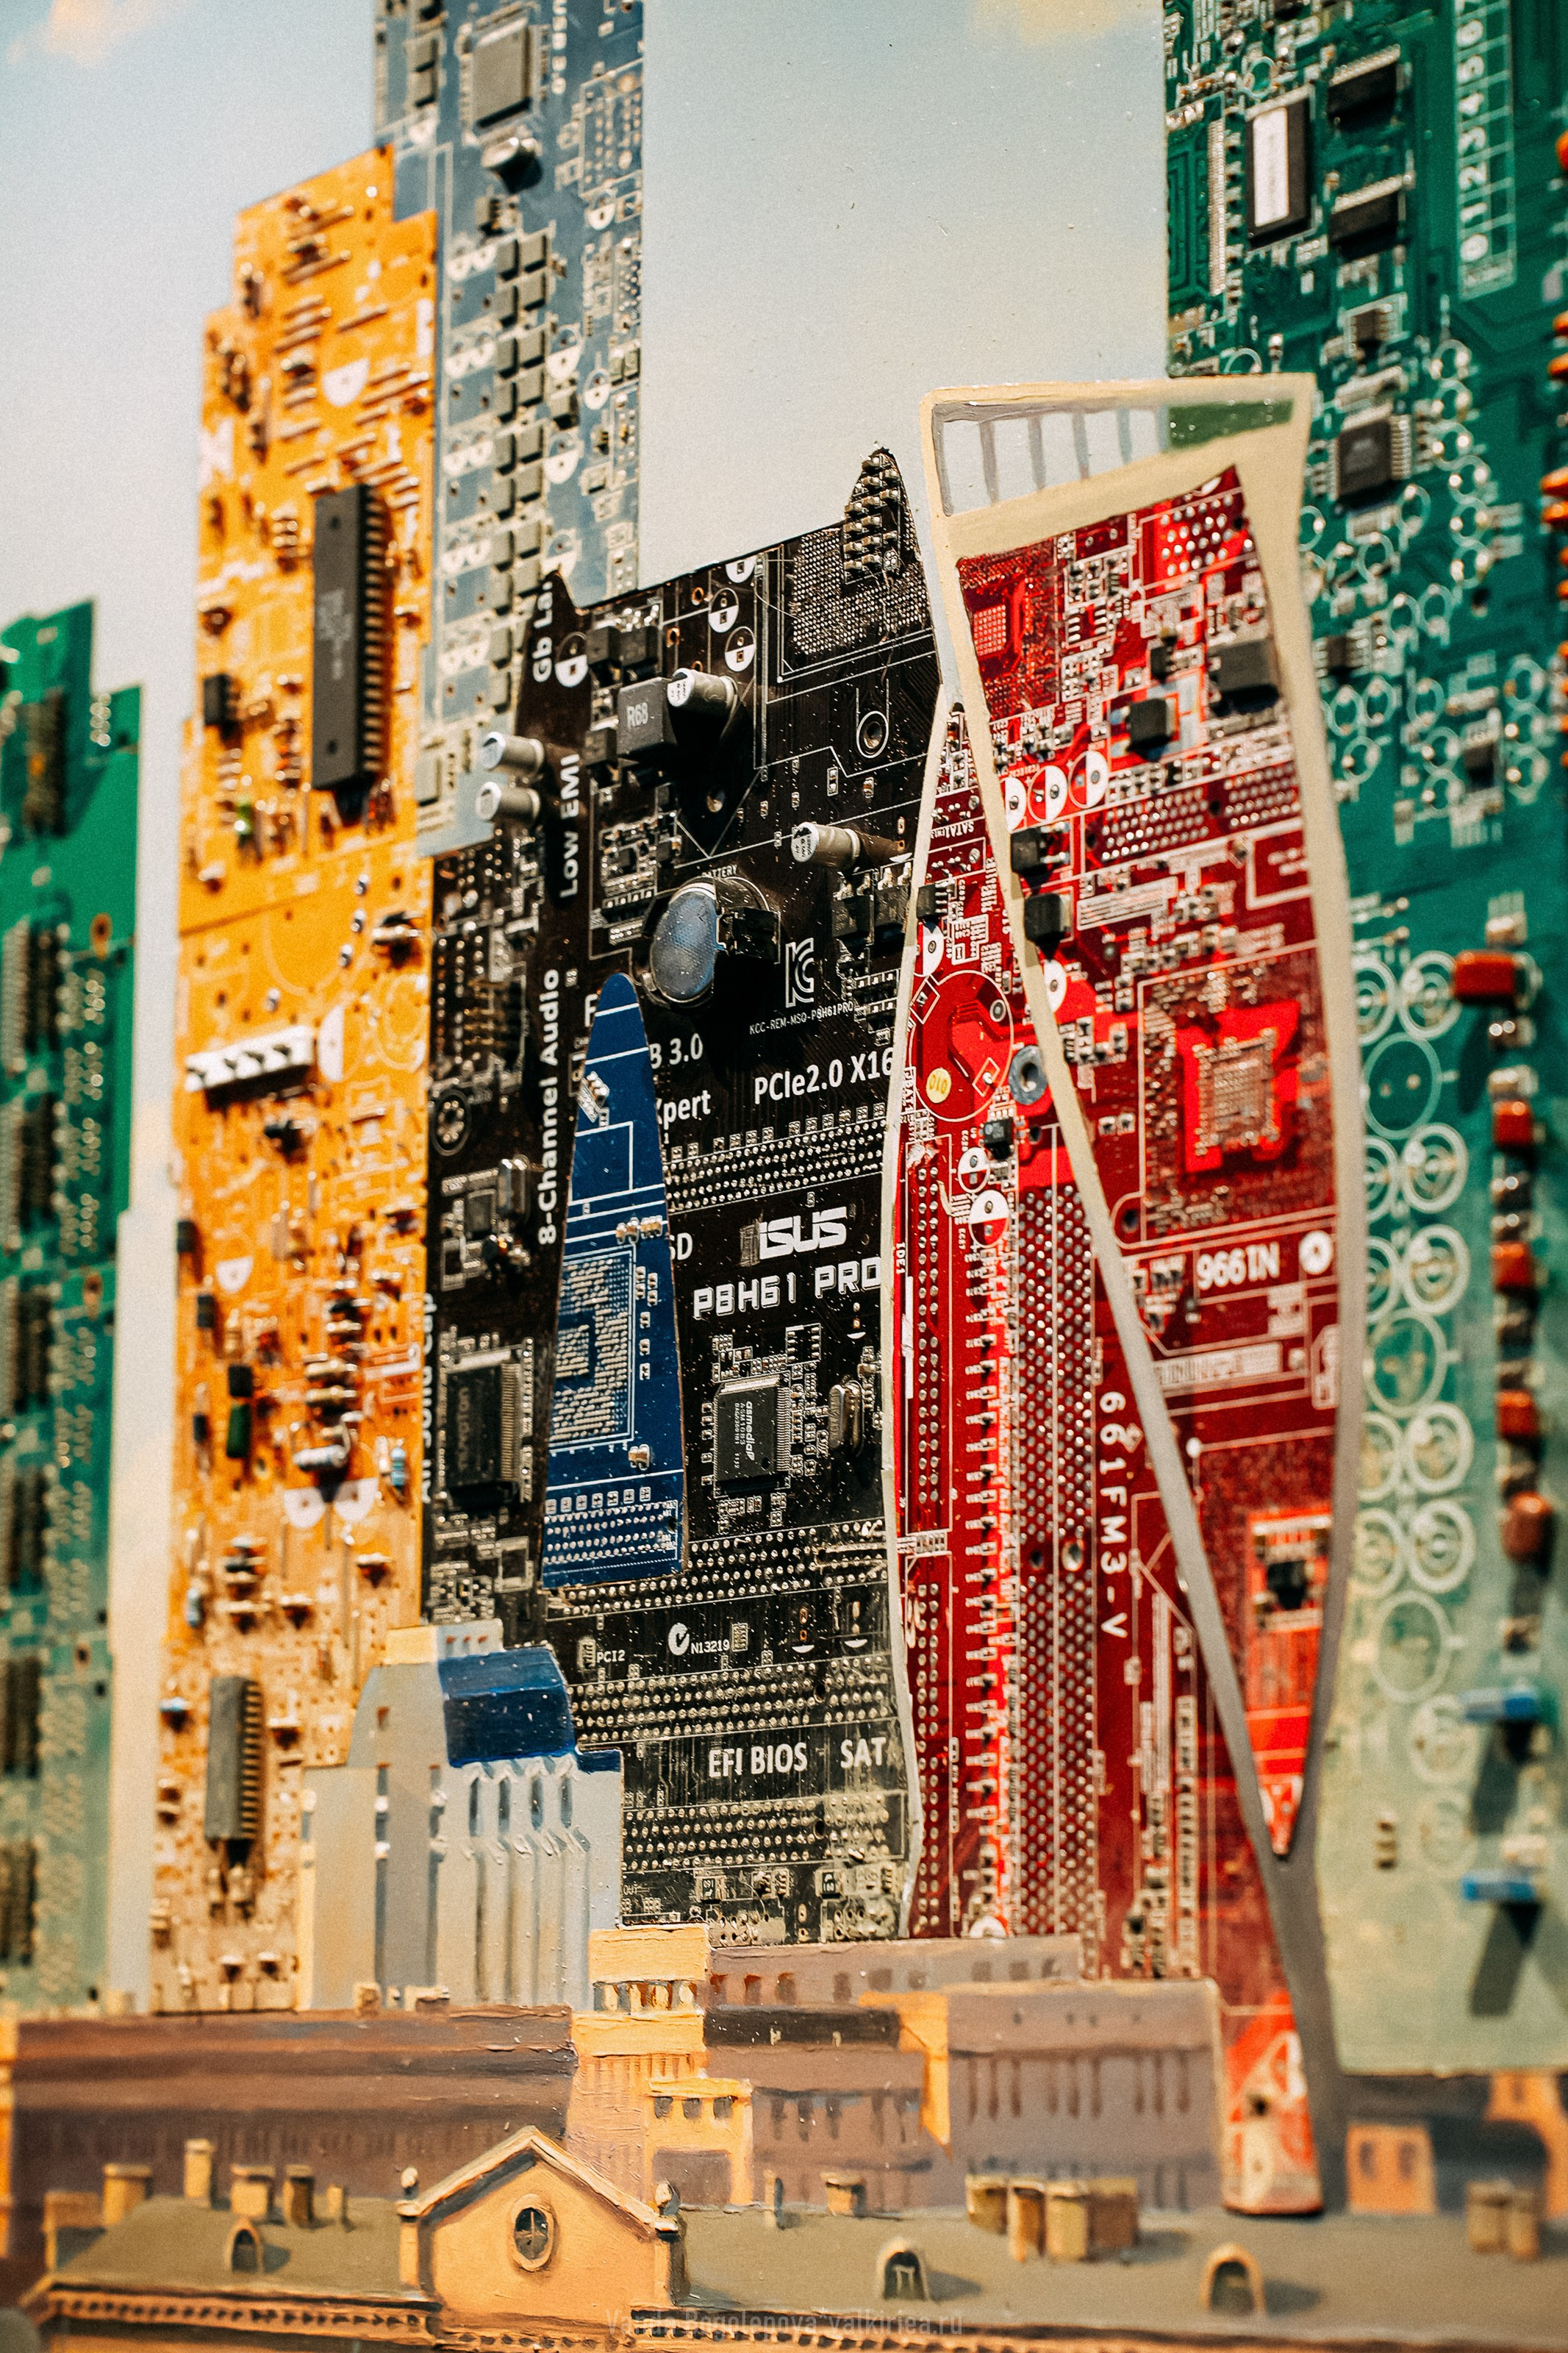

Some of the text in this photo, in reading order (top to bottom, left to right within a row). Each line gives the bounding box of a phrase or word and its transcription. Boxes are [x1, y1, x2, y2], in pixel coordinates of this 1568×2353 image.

[560, 754, 580, 819] EMI
[669, 1032, 704, 1065] 3.0
[850, 1046, 892, 1084] X16
[537, 969, 559, 1245] 8-Channel Audio
[896, 1242, 906, 1275] IDE1
[693, 1256, 881, 1321] P8H61 PRO
[1100, 1390, 1128, 1638] 661FM3-V
[597, 1649, 626, 1663] PCI2
[690, 1638, 730, 1655] N13219
[708, 1749, 742, 1779] EFI
[751, 1741, 807, 1775] BIOS
